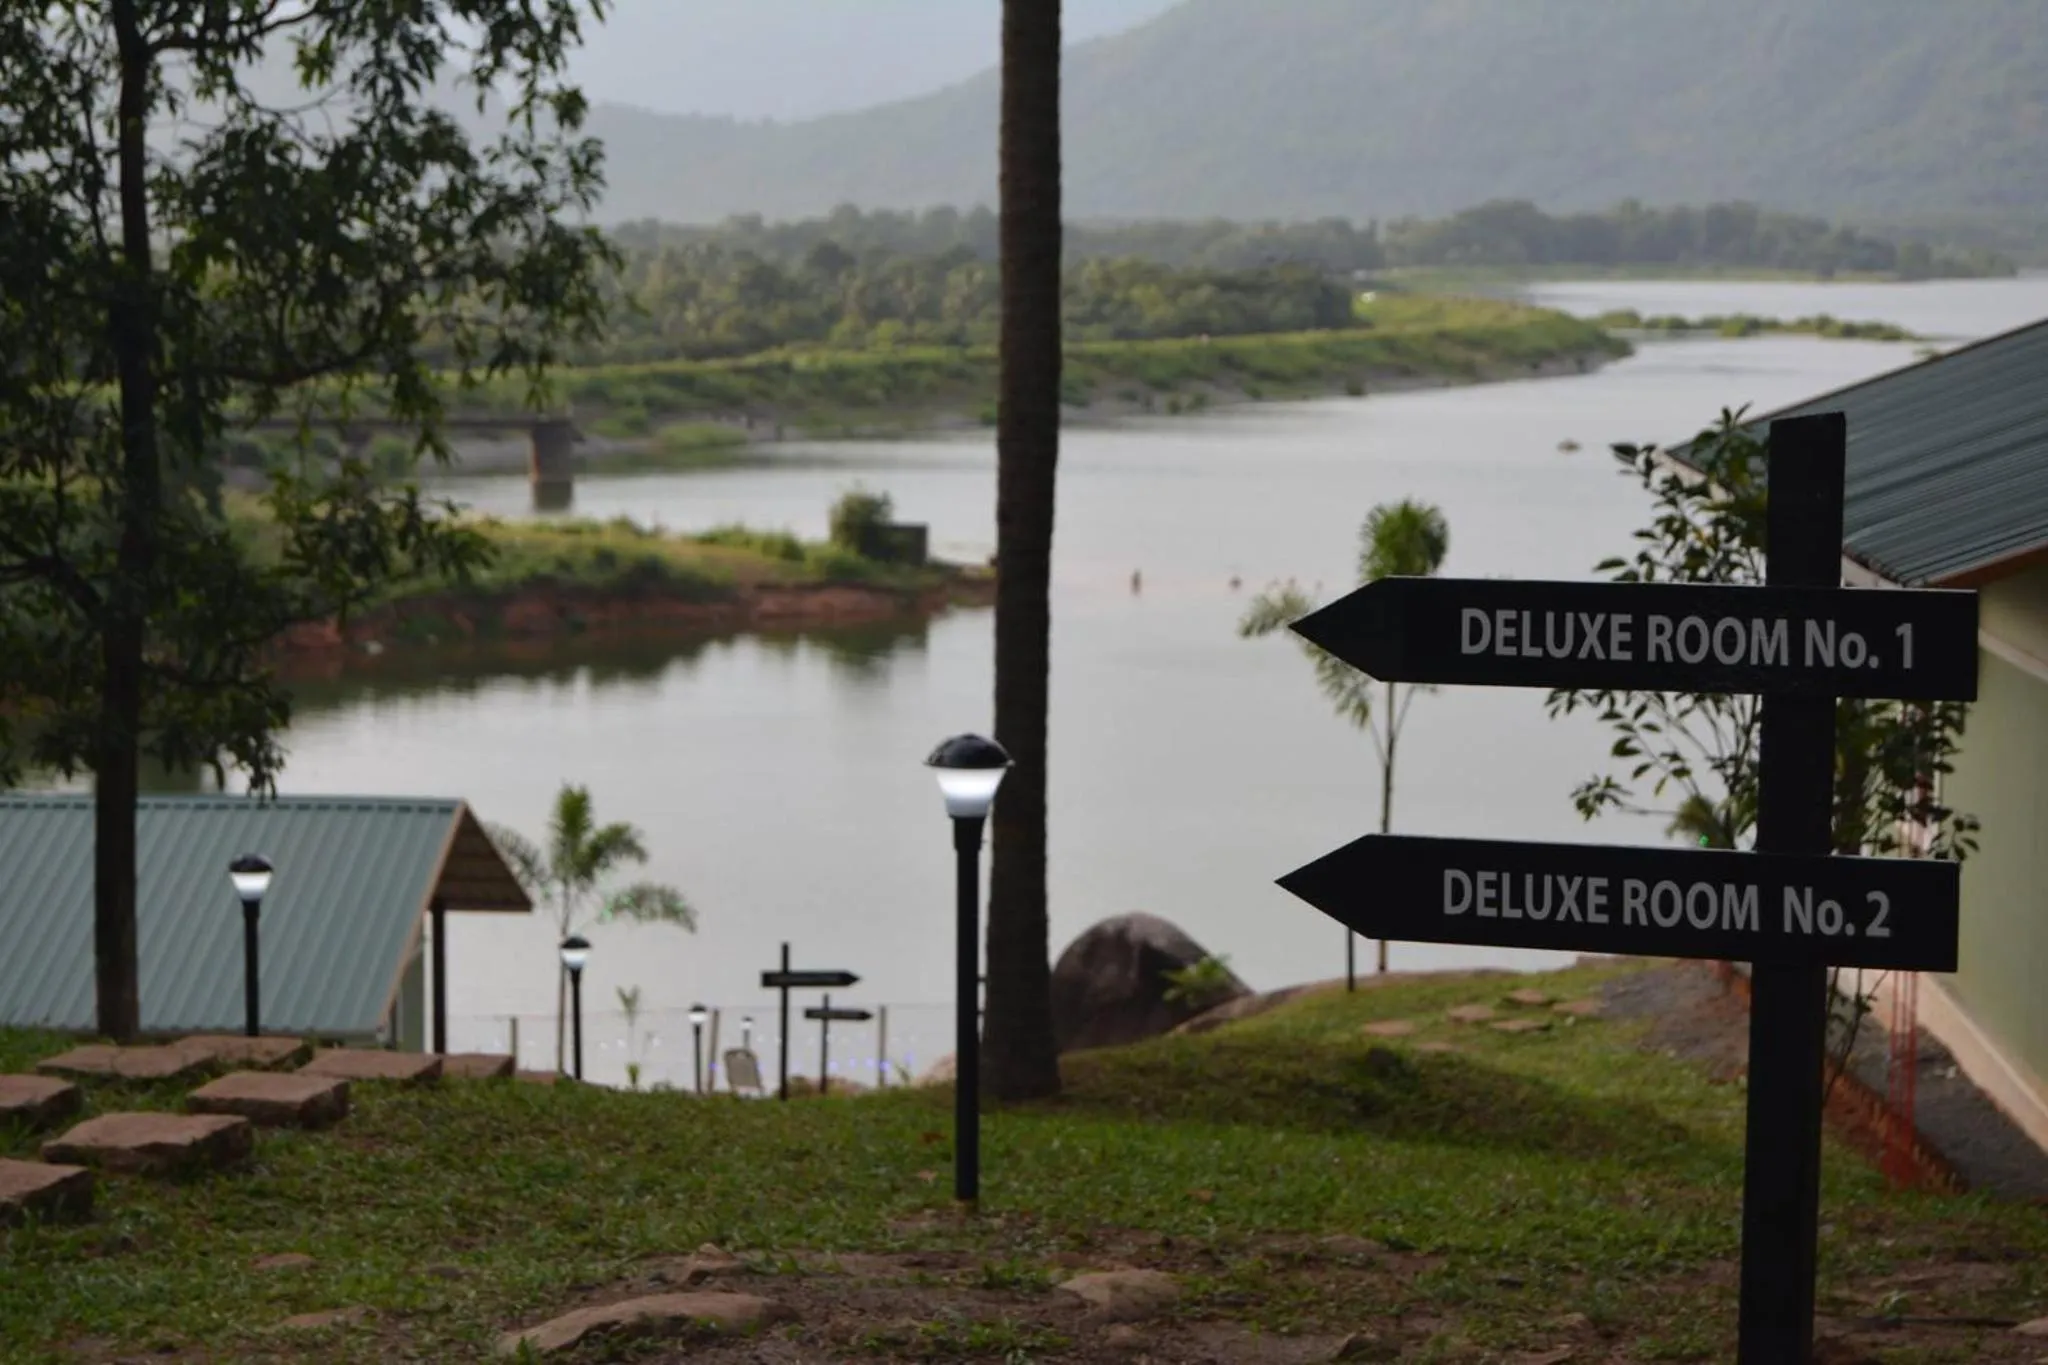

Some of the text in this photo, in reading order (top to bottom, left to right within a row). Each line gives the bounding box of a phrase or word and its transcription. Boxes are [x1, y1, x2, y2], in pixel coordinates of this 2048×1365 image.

[1461, 607, 1914, 669] DELUXE ROOM No. 1
[1443, 868, 1891, 938] DELUXE ROOM No. 2
